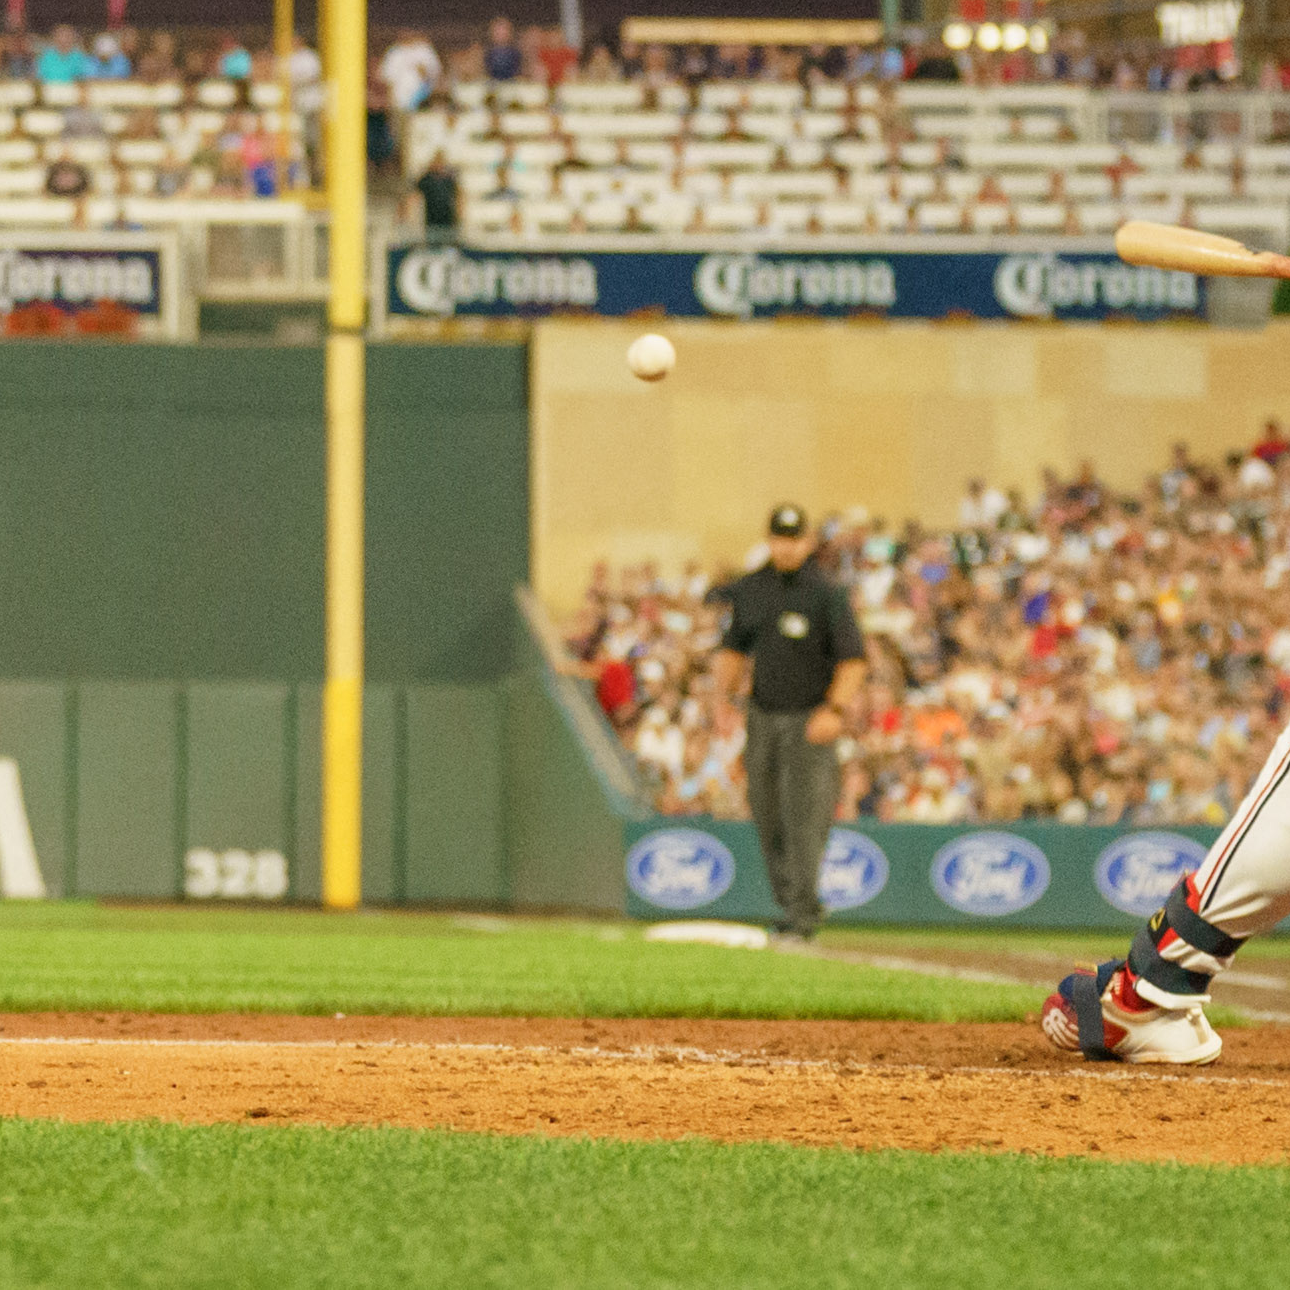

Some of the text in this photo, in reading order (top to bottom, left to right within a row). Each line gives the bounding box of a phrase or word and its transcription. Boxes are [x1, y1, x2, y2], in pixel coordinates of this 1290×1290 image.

[396, 247, 1197, 319] Corona Corona Corona
[185, 847, 289, 899] 328
